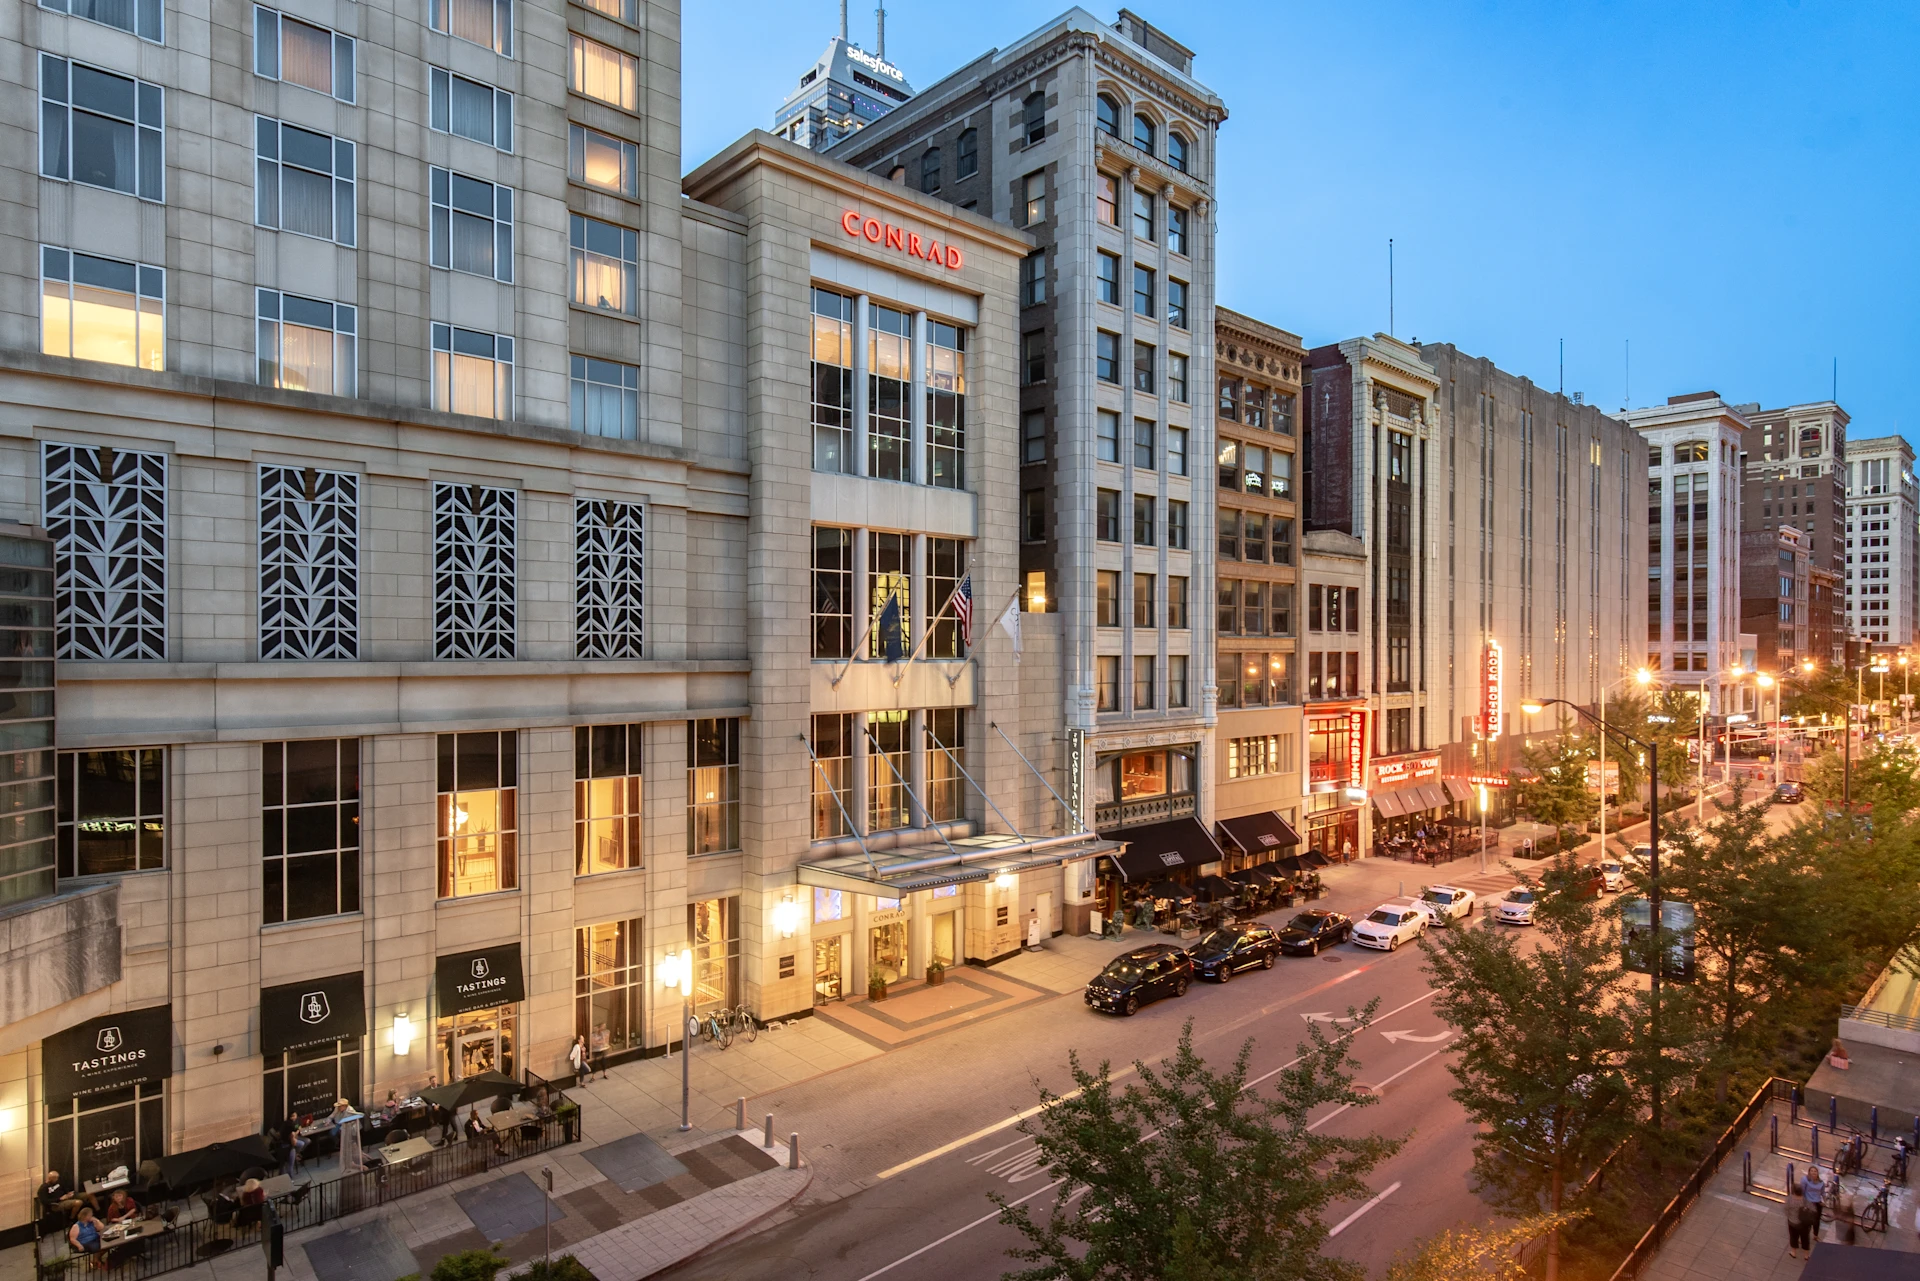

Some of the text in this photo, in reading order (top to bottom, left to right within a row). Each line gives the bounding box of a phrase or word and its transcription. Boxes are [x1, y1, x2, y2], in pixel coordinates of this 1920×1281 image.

[846, 46, 904, 82] salesforce
[842, 210, 964, 270] CONRAD
[1488, 650, 1498, 730] ROCK BOTTOM
[1350, 714, 1361, 788] SUGARFIRE
[1378, 762, 1404, 776] ROCK
[873, 910, 906, 922] CONRAD
[456, 976, 506, 993] TASTINGS
[309, 1033, 350, 1046] EXPERIENCE
[72, 1049, 146, 1072] TASTINGS
[103, 1063, 138, 1073] EXPERIENCE
[72, 1088, 92, 1097] WINE
[120, 1076, 148, 1087] BISTRO
[312, 1092, 333, 1101] PLATES
[95, 1136, 120, 1150] 200
